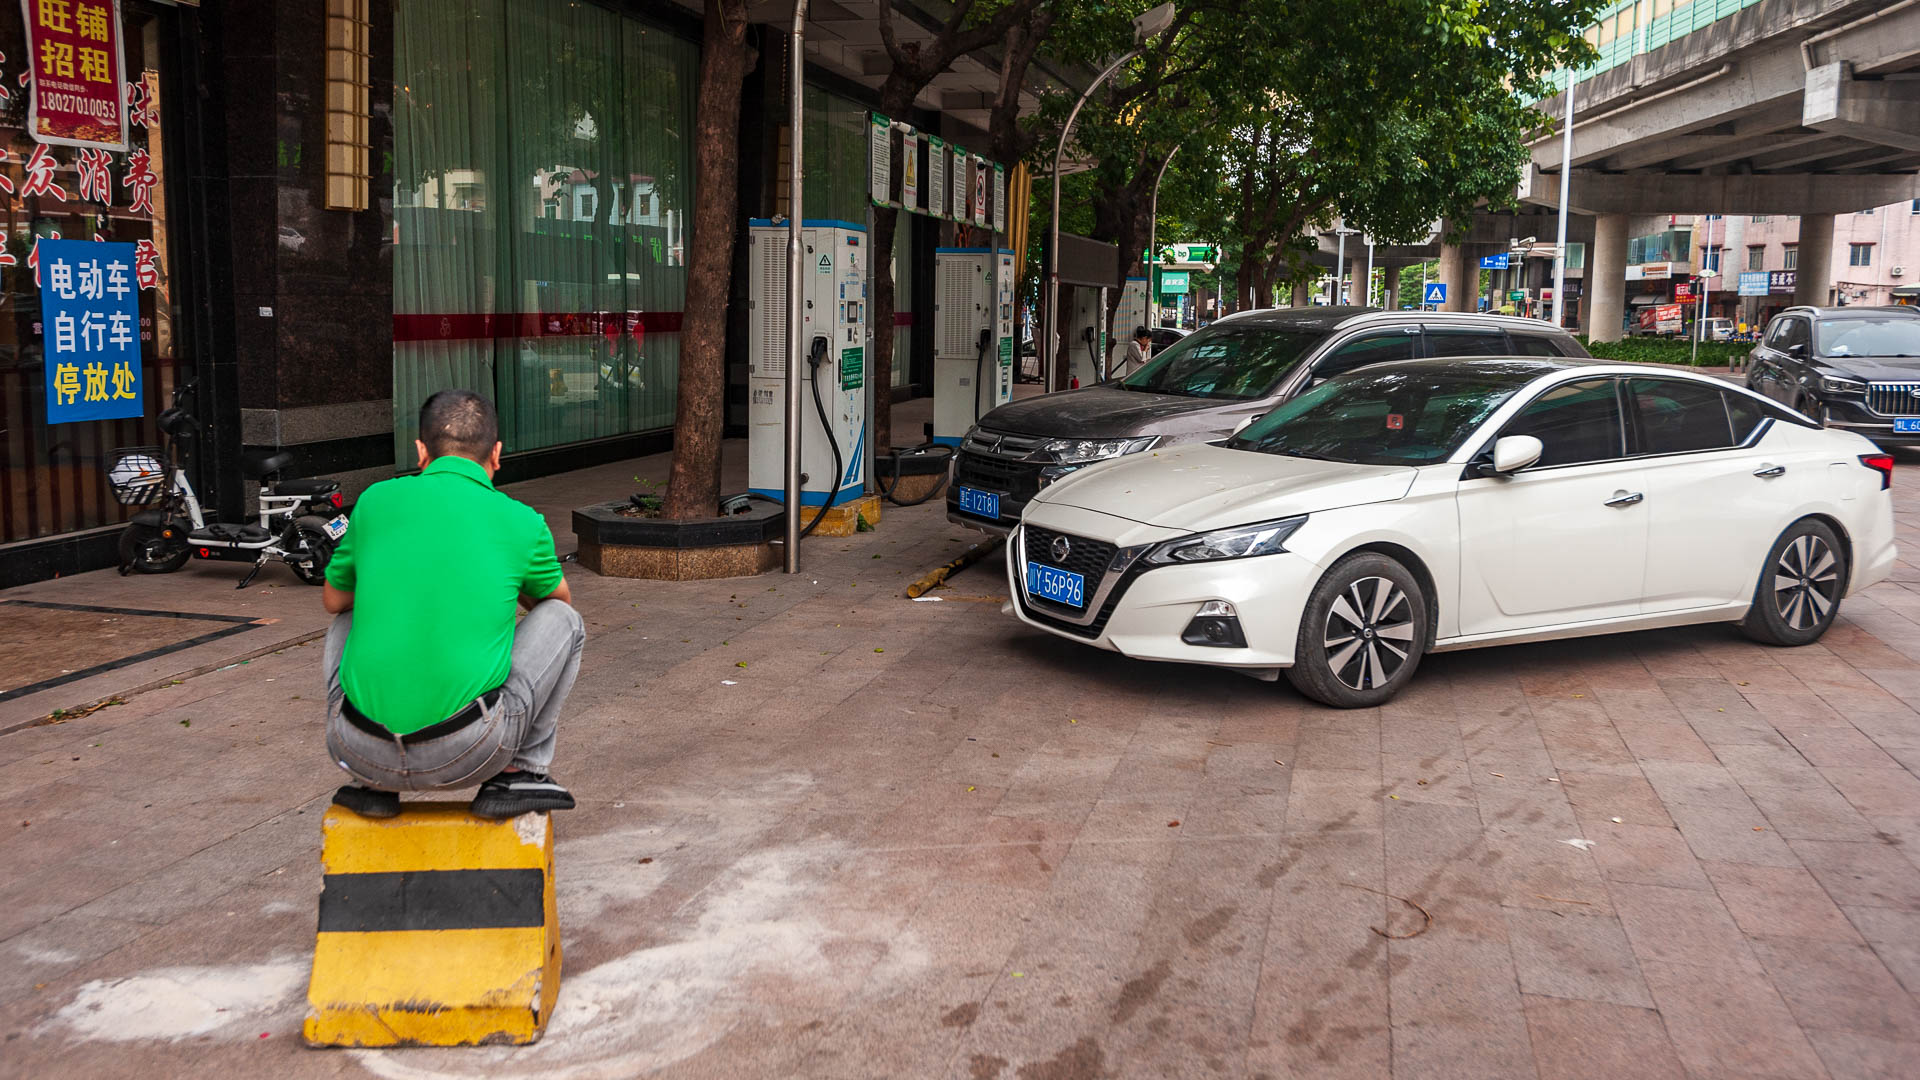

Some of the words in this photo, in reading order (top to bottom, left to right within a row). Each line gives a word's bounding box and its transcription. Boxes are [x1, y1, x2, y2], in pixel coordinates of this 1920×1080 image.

[38, 0, 108, 42] 旺铺
[40, 39, 112, 84] 招租
[41, 92, 116, 119] 18027010053
[50, 258, 130, 301] 电动车
[54, 310, 132, 353] 自行车
[53, 361, 136, 405] 停放处
